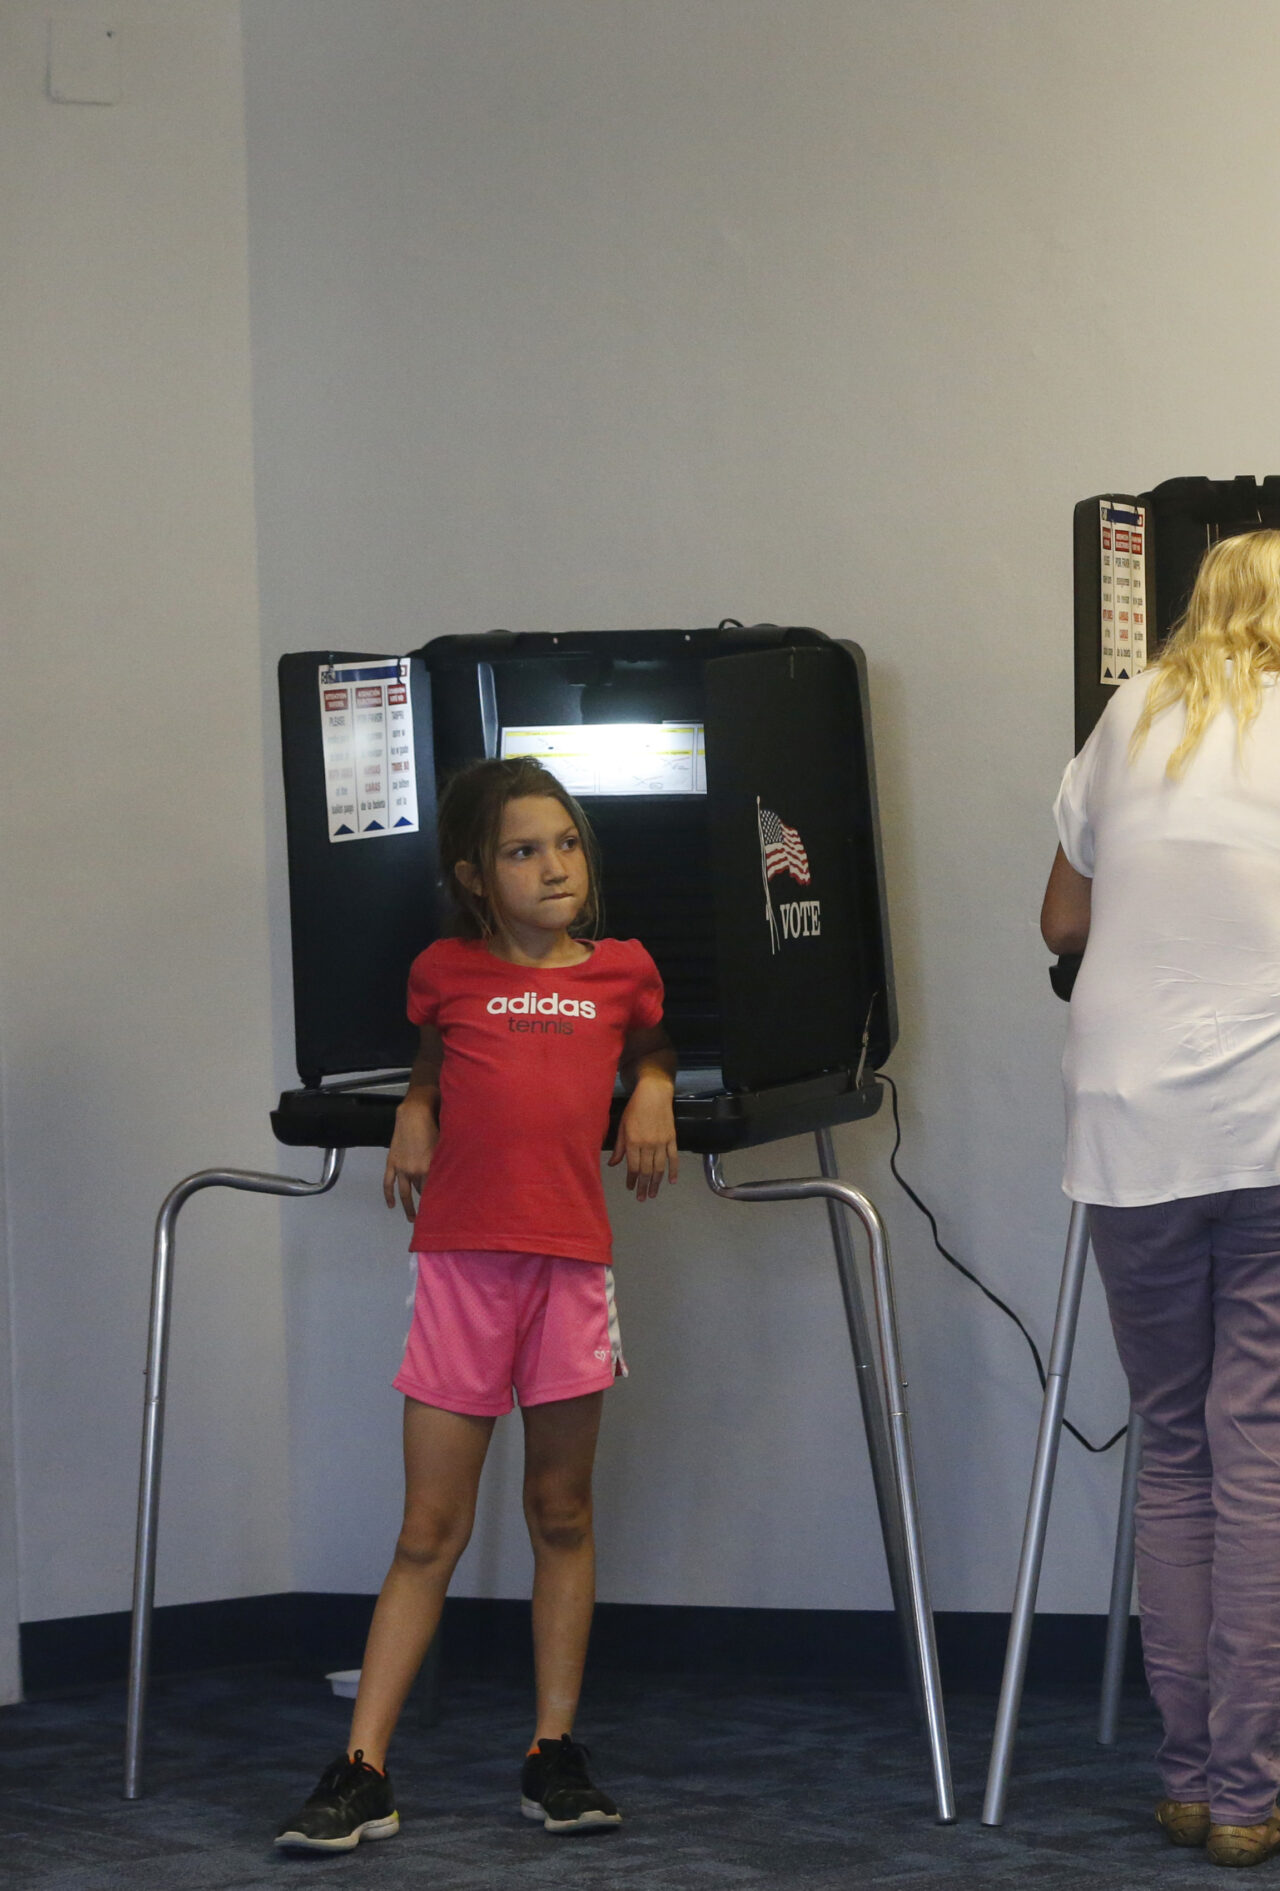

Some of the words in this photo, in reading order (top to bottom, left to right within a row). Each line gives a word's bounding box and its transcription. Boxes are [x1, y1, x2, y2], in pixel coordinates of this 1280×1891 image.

[780, 900, 821, 939] VOTE
[487, 992, 597, 1019] adidas
[508, 1017, 574, 1035] tennis
